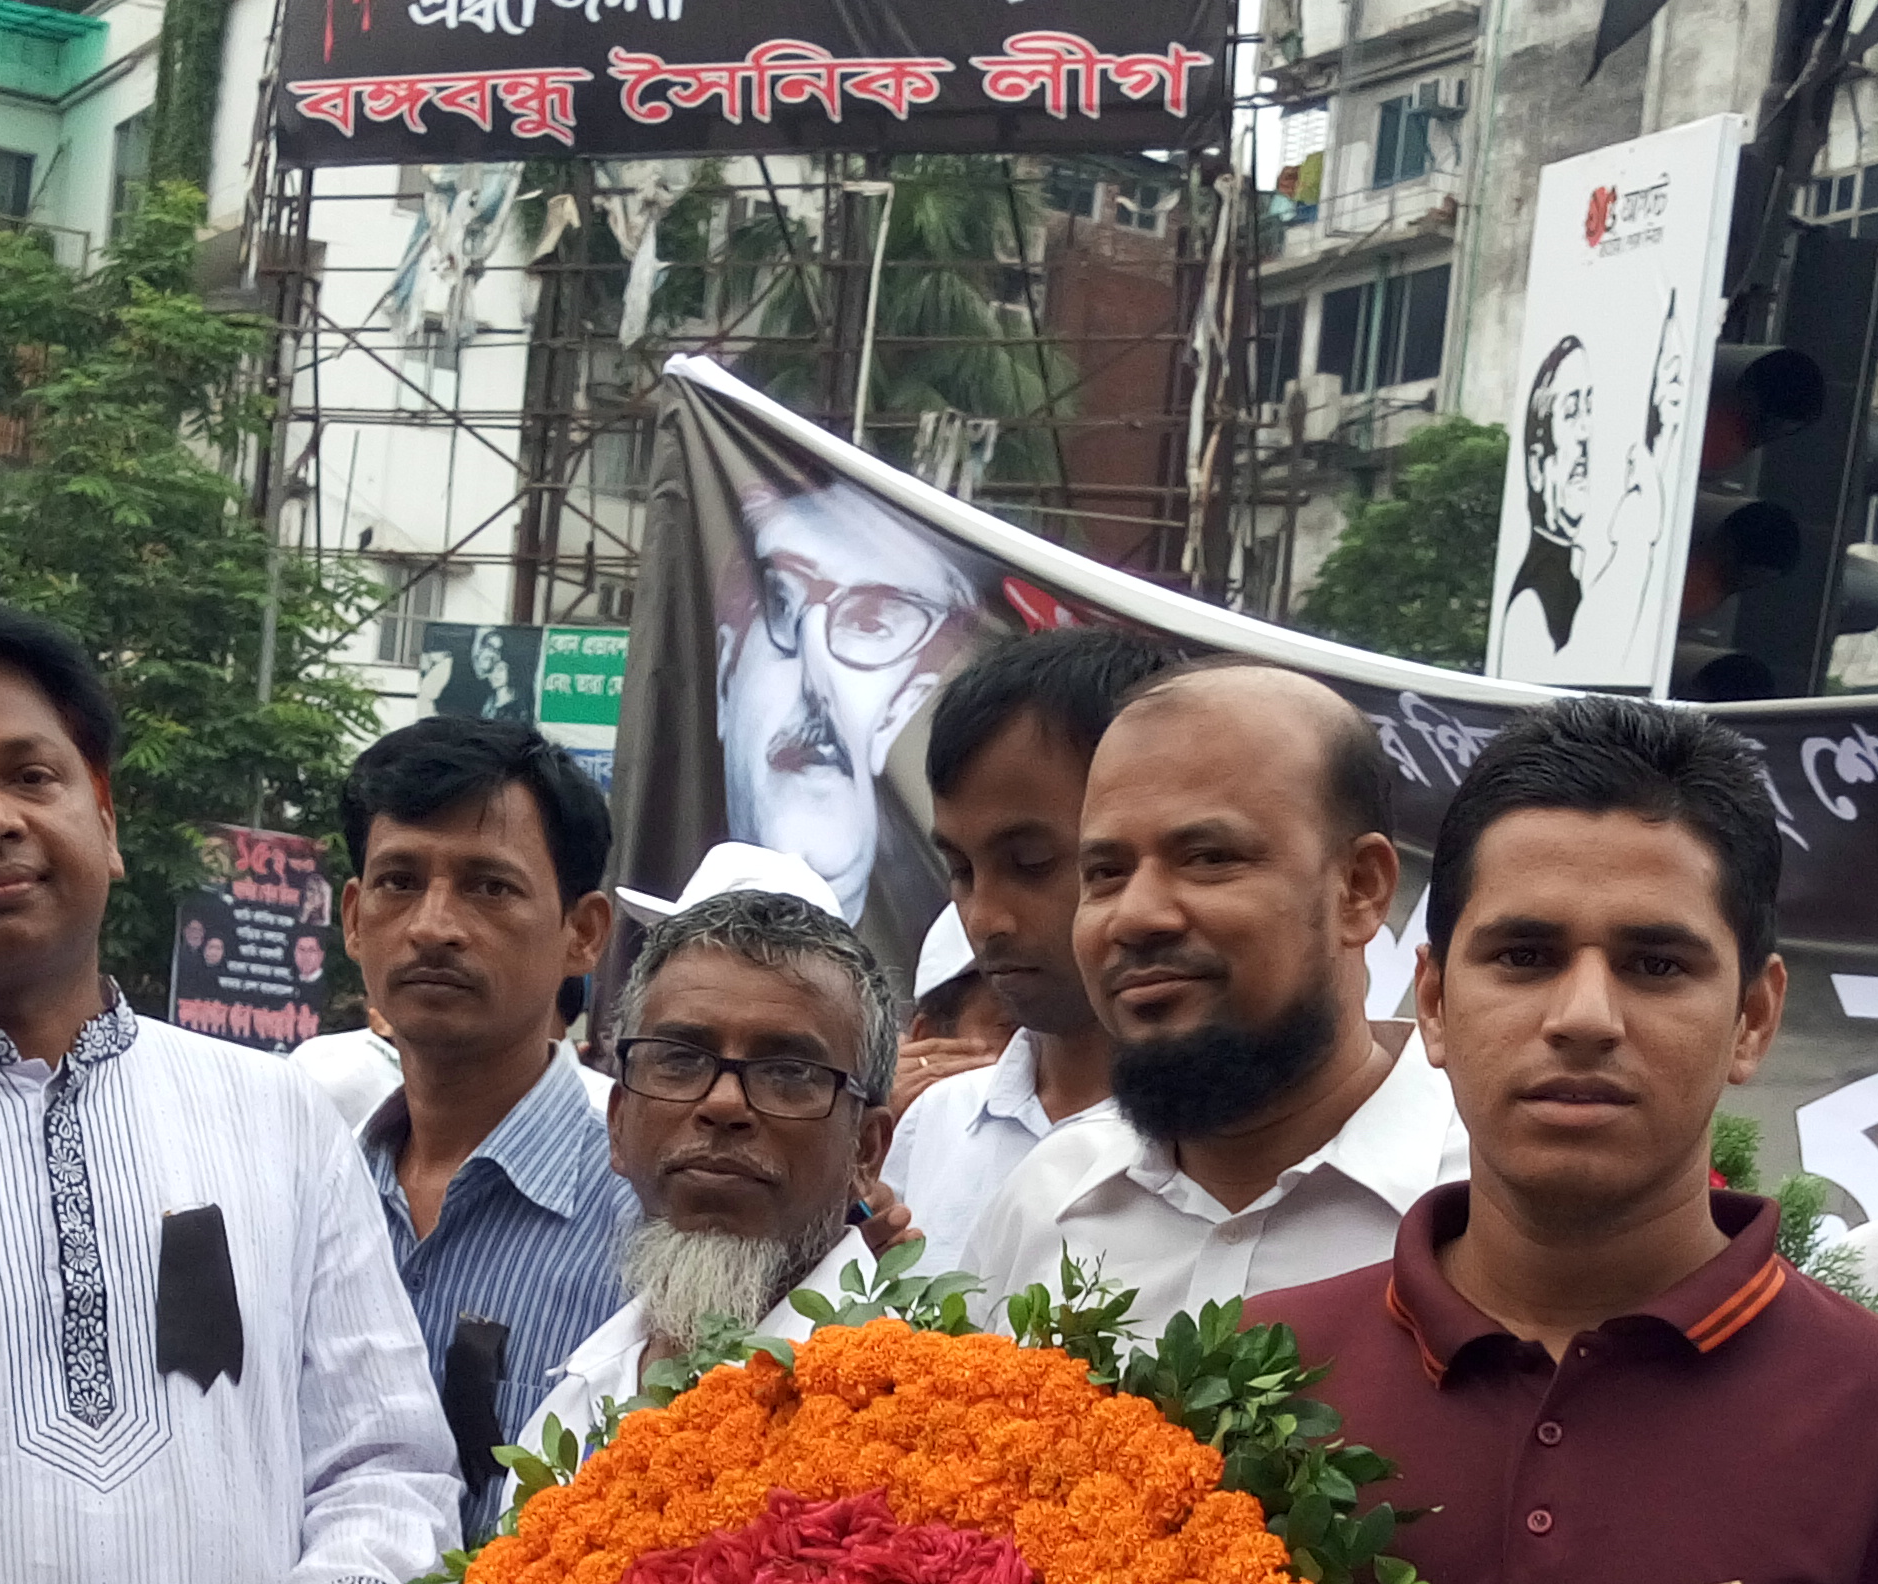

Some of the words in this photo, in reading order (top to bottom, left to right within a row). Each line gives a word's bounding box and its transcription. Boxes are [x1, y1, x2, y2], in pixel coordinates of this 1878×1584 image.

[287, 66, 594, 146] বঙ্গবন্ধু
[608, 37, 956, 124] সৈনিক
[968, 30, 1215, 119] লীগ
